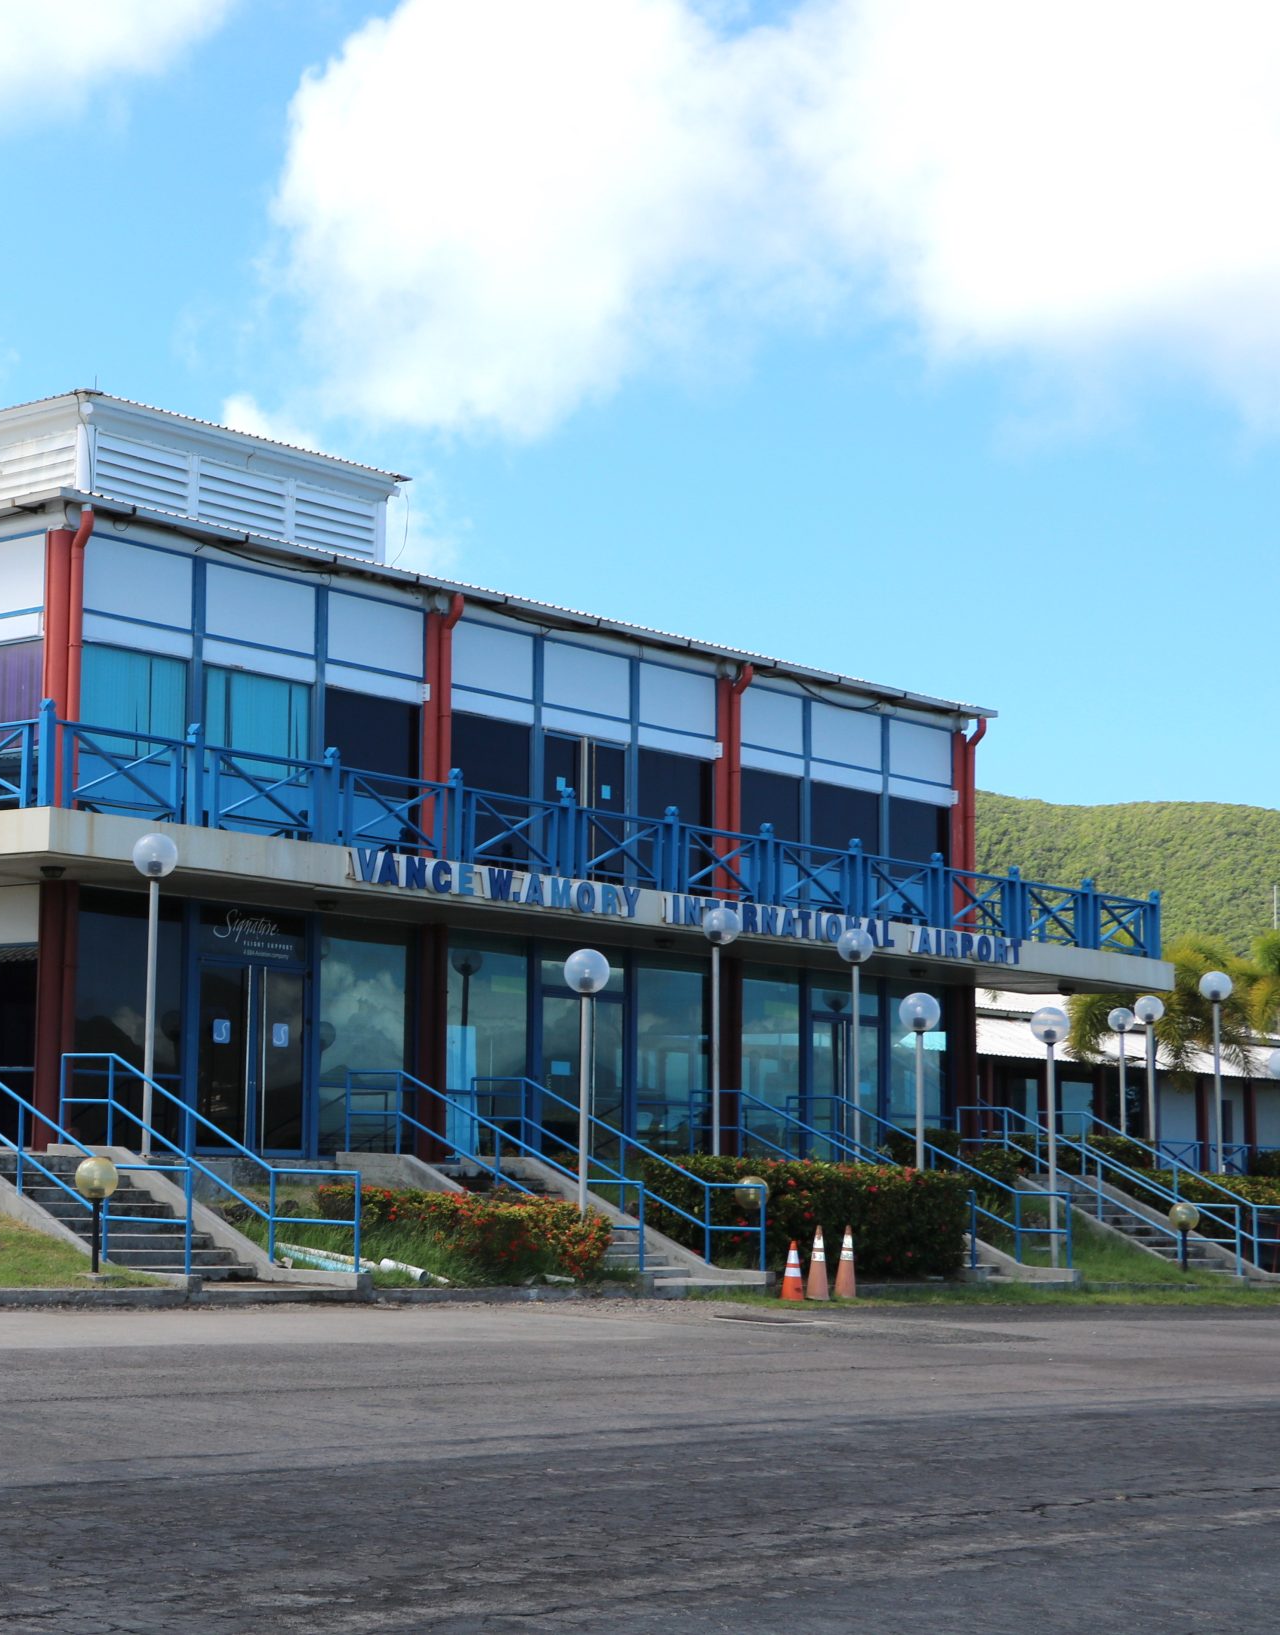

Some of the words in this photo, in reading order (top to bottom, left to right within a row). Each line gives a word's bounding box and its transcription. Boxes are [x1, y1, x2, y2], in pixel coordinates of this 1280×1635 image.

[212, 908, 278, 943] Signature
[356, 847, 475, 896] VANCE
[672, 894, 895, 947] INRNATIOAL
[917, 926, 1022, 965] AIRPORT
